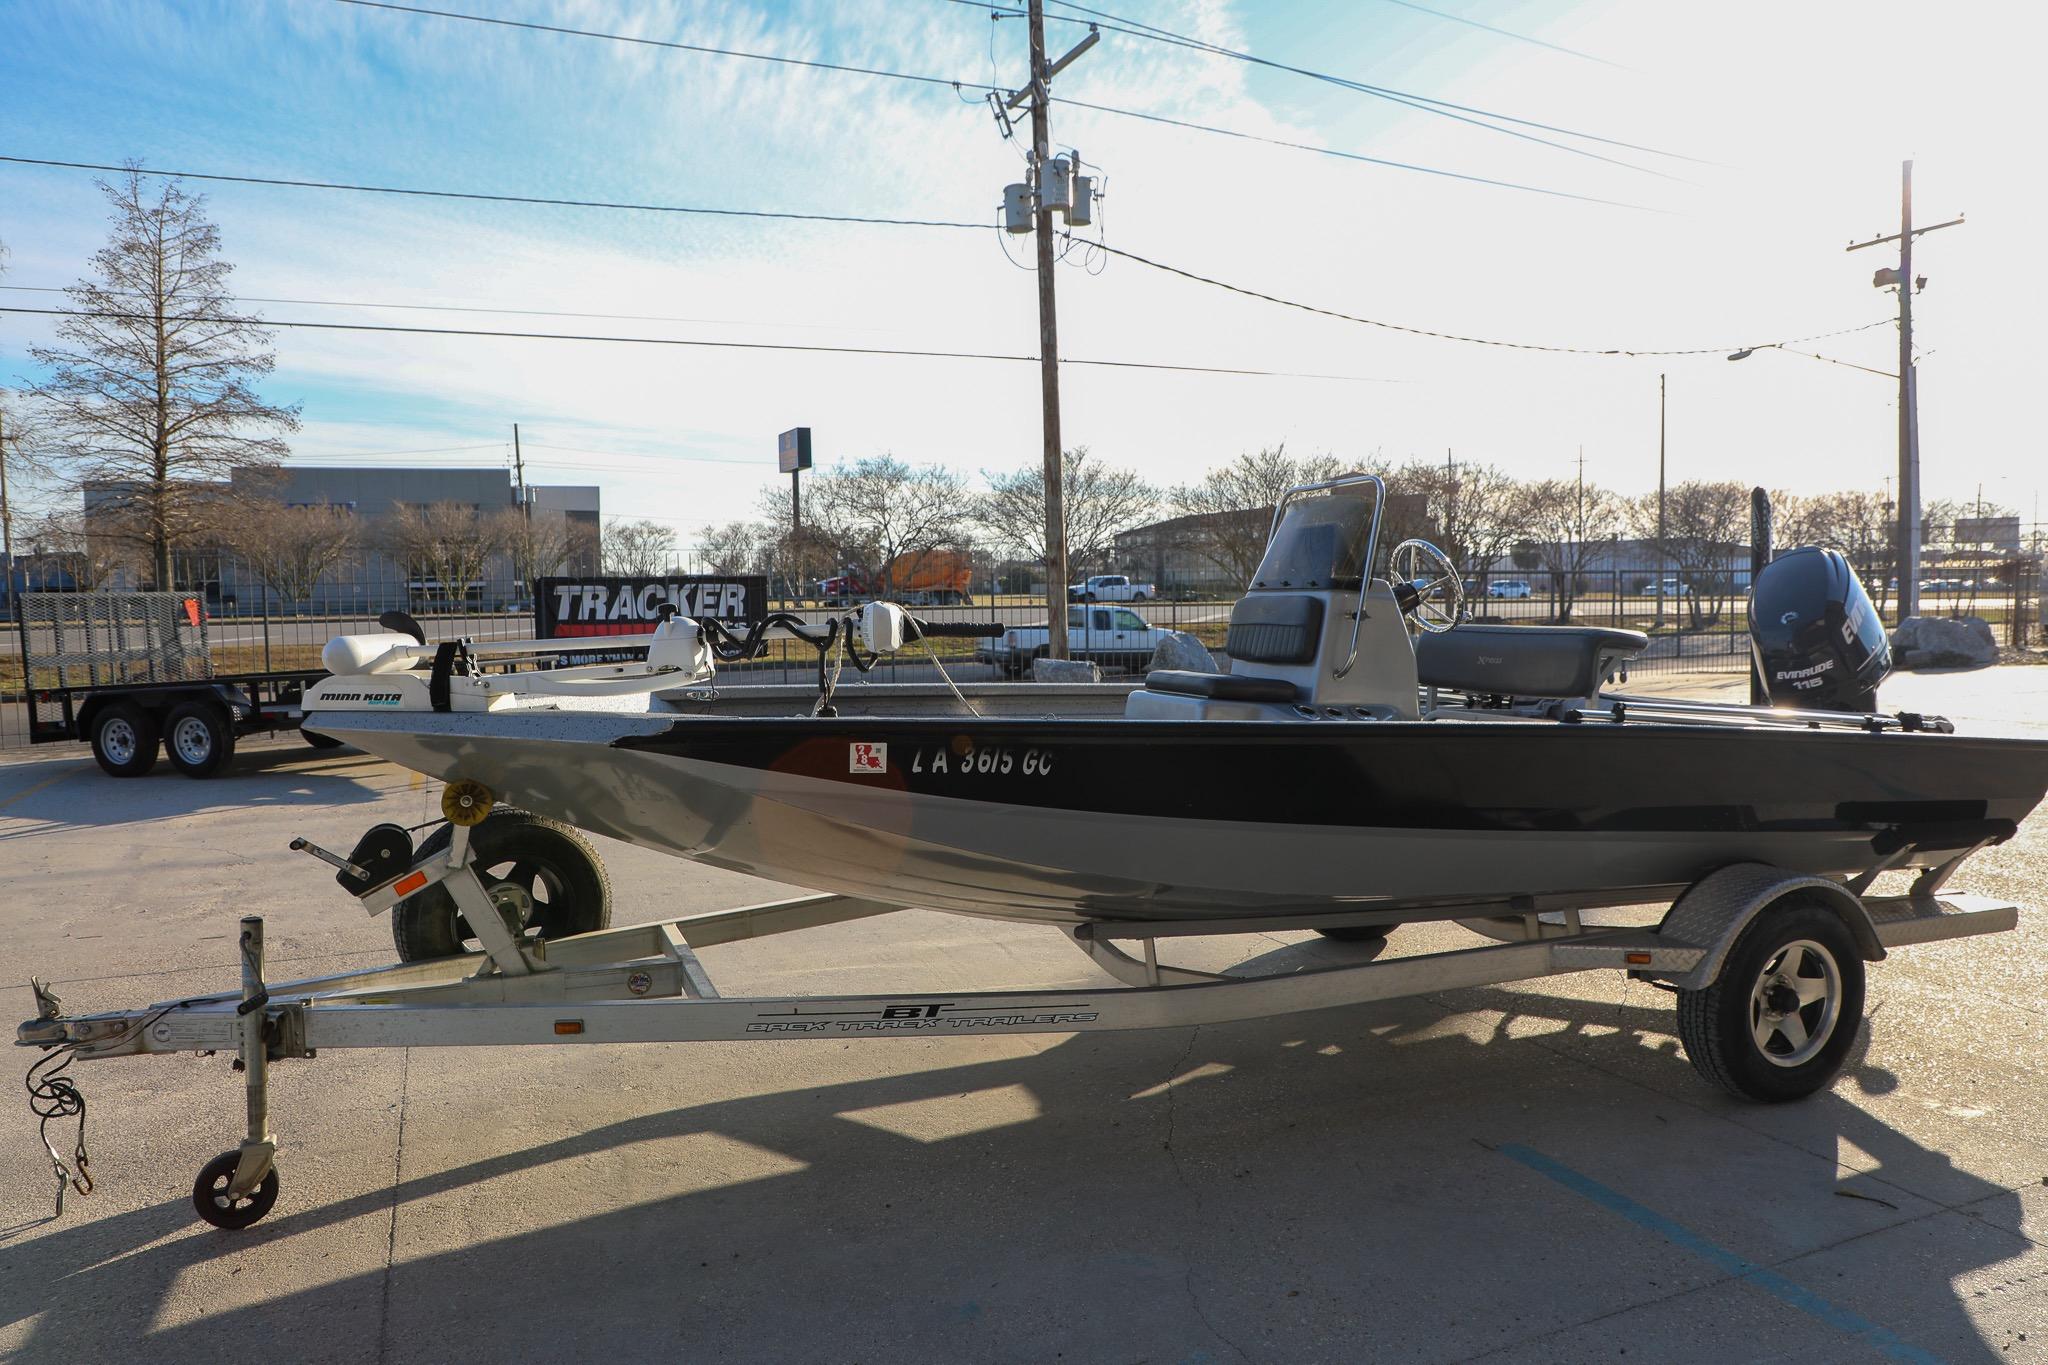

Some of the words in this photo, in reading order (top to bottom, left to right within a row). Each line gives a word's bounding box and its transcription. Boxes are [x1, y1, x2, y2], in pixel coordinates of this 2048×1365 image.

[553, 583, 747, 621] TRACKER
[570, 654, 603, 665] MORE
[1776, 659, 1835, 680] EVINRUDE
[1792, 677, 1824, 690] 115
[320, 693, 362, 701] MINN
[362, 693, 402, 701] KOTA
[961, 747, 1013, 774] 3615
[1022, 748, 1052, 775] GC
[881, 1003, 955, 1019] BT
[746, 1021, 832, 1032] BACK
[836, 1018, 942, 1030] TRACK
[948, 1012, 1099, 1028] TRAILERS
